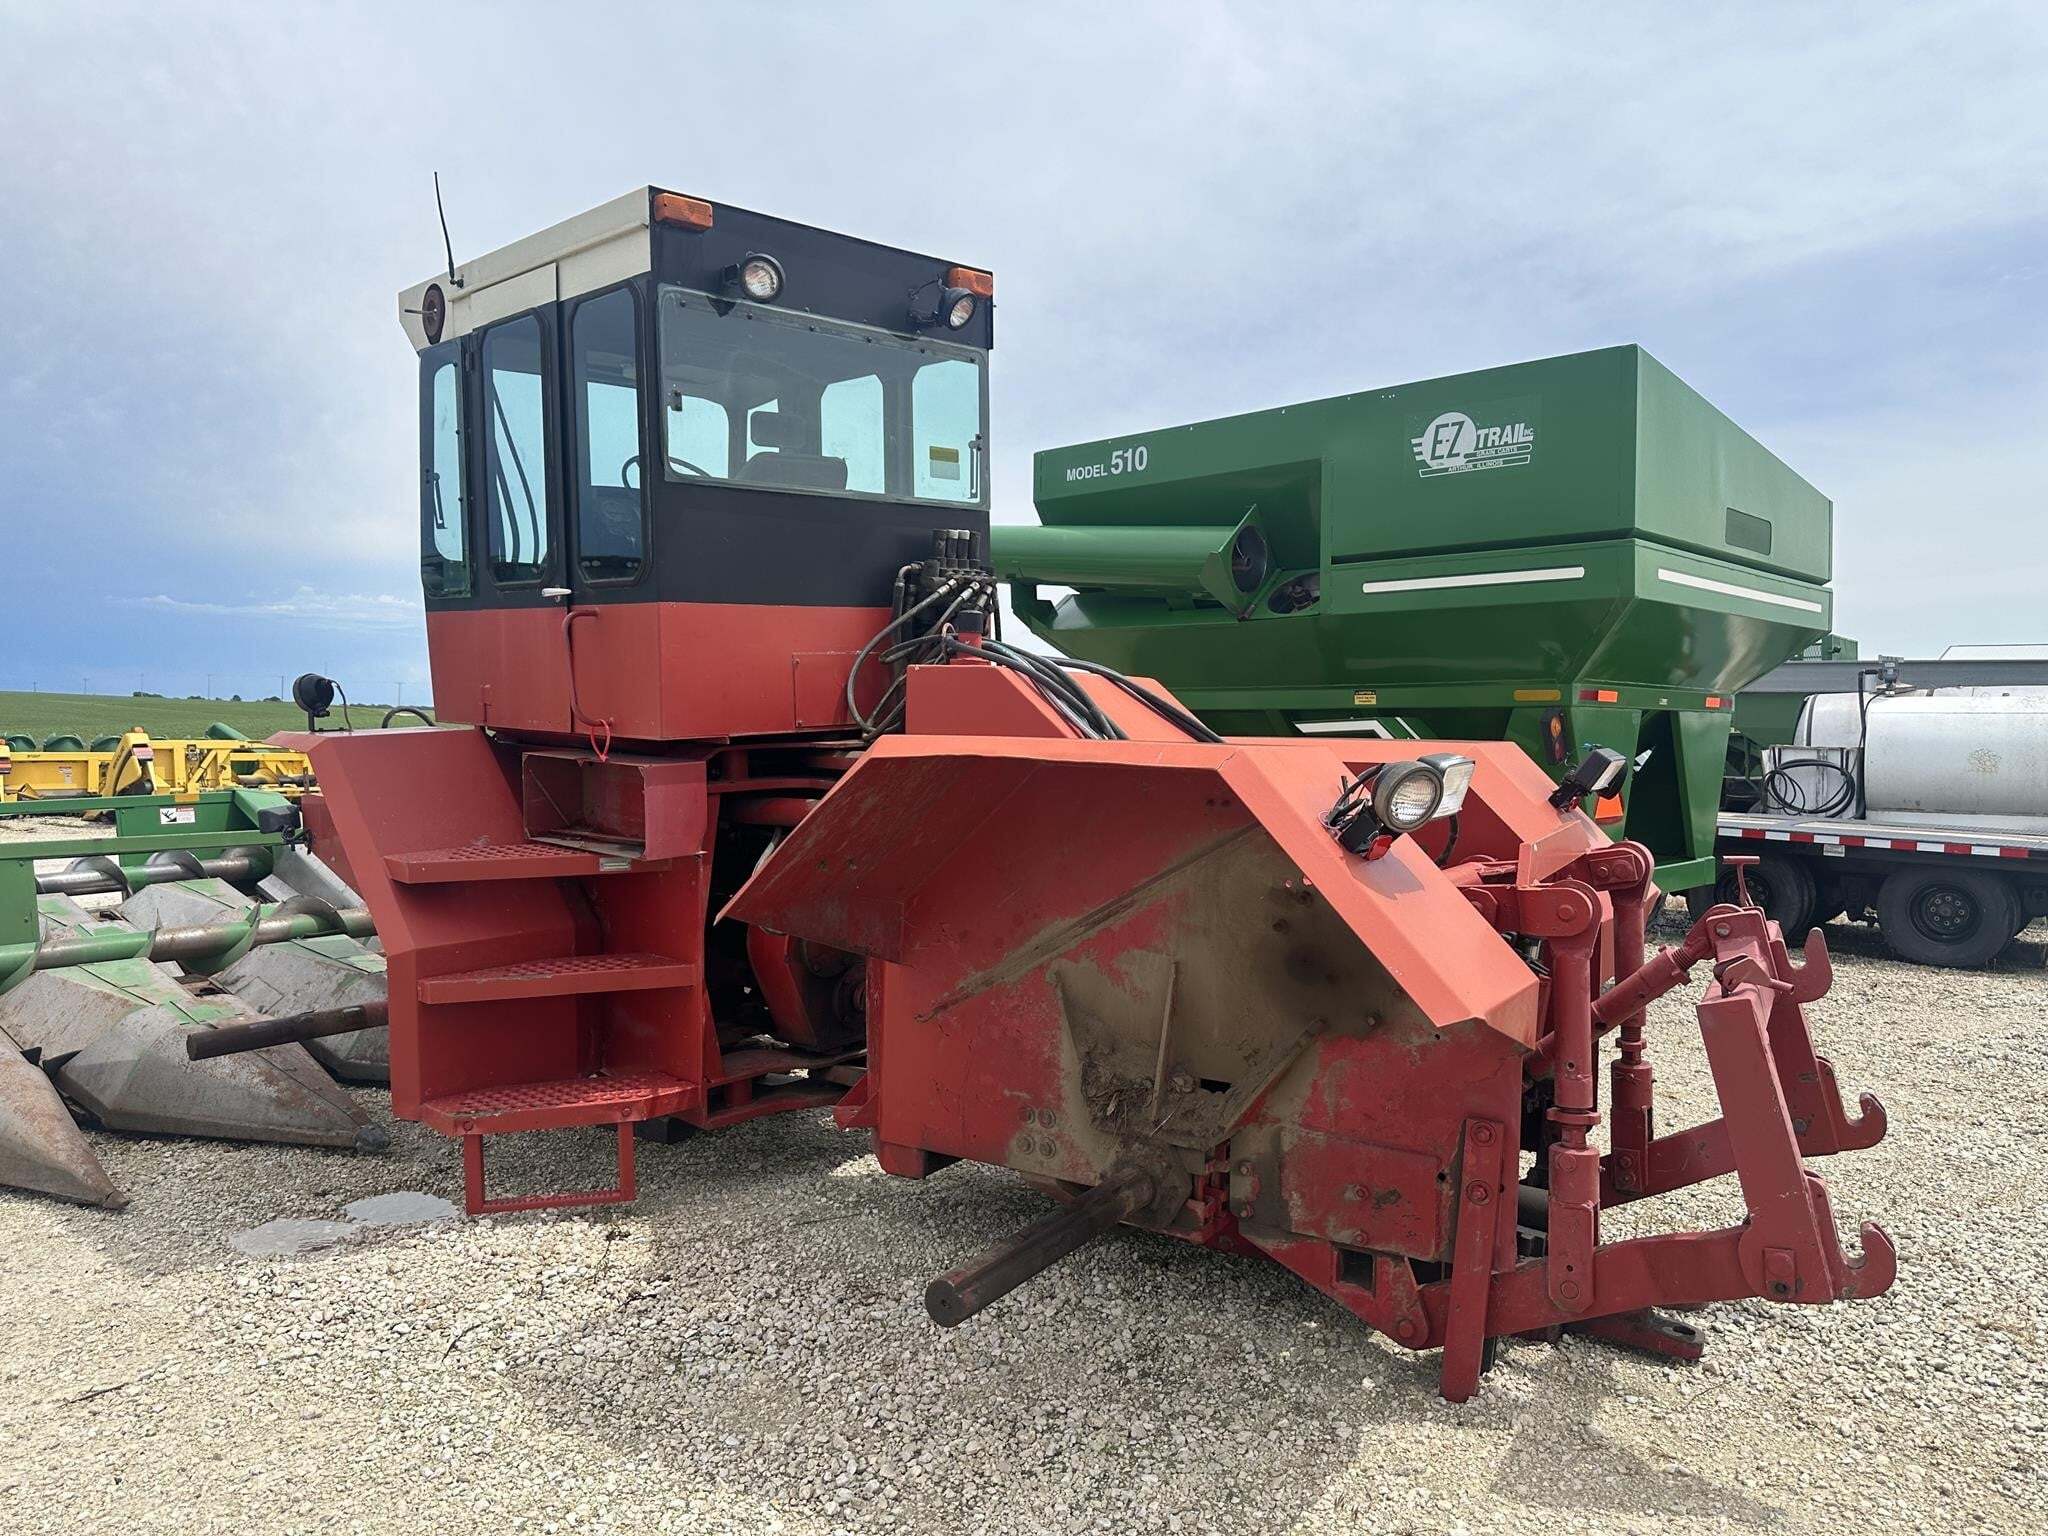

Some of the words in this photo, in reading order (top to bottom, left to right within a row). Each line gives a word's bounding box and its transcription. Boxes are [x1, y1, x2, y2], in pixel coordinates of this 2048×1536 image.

[1477, 423, 1533, 448] TRAIL
[1066, 464, 1108, 481] MODEL
[1111, 446, 1147, 474] 510
[1477, 459, 1503, 468] ILLINOIS
